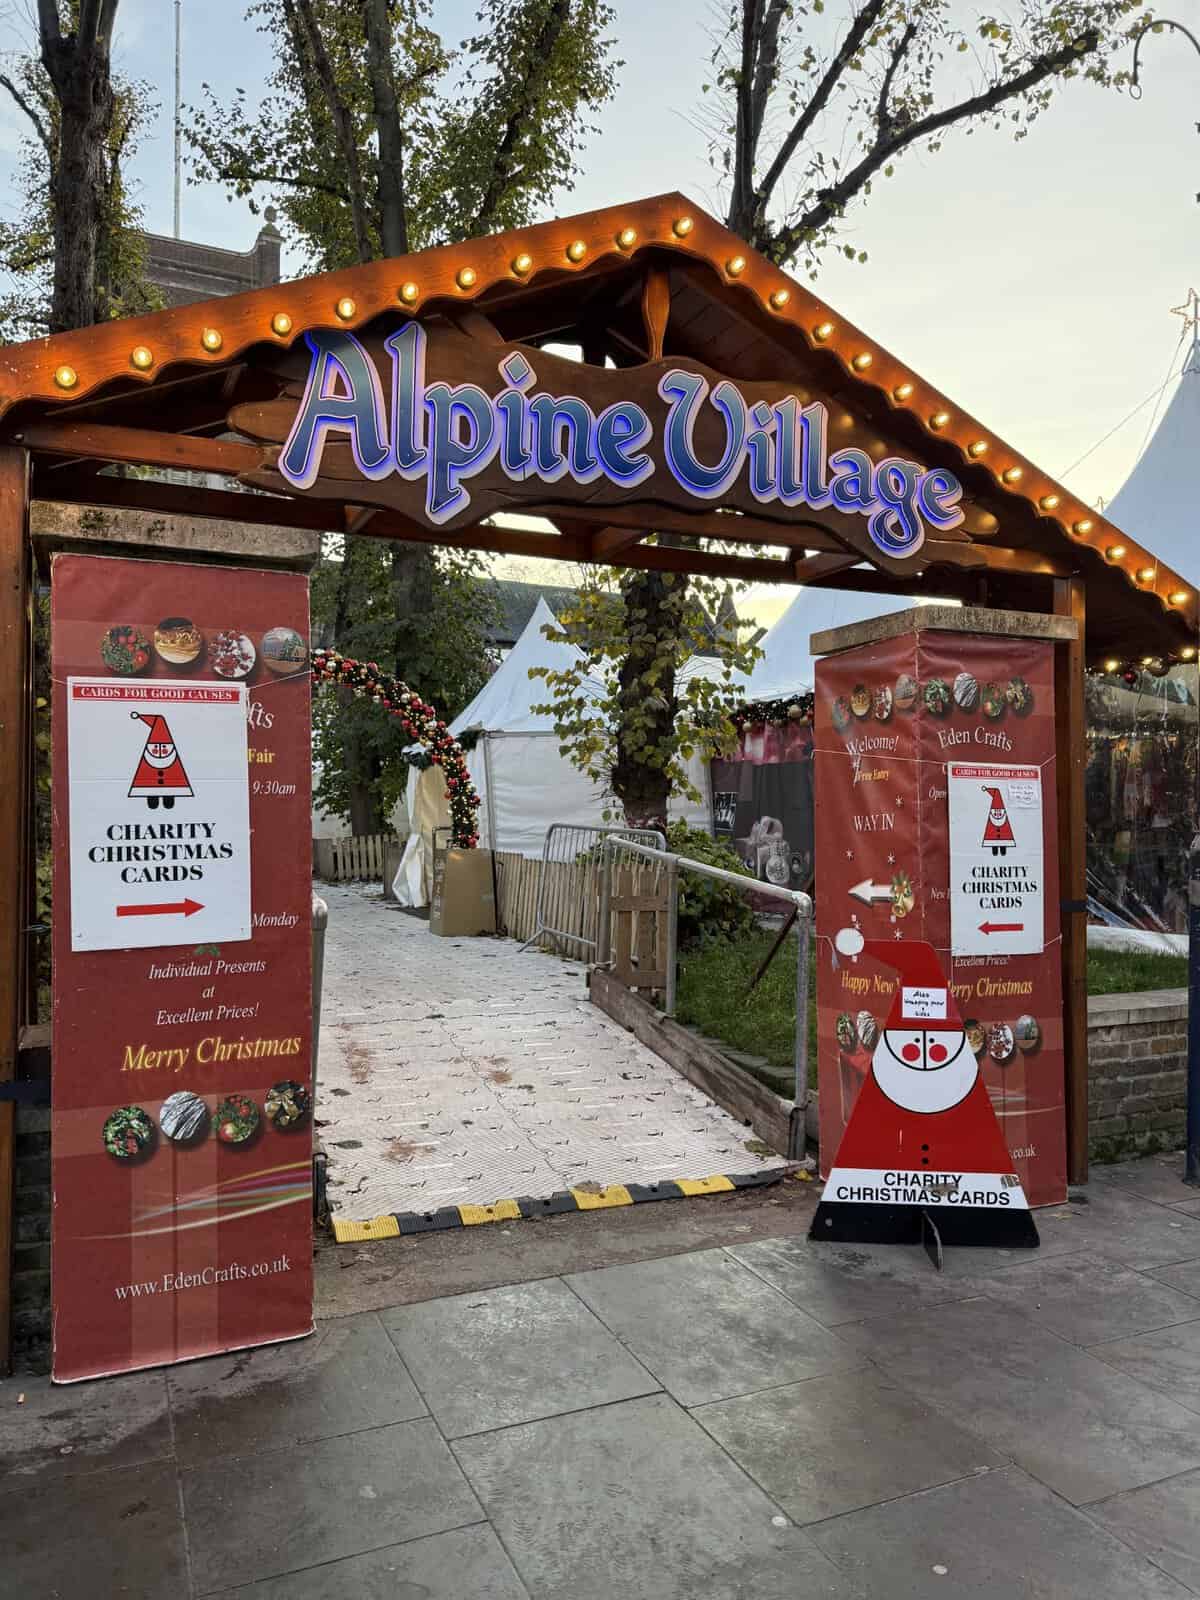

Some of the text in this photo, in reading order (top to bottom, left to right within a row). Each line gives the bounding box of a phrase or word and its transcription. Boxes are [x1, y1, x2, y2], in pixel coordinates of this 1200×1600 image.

[279, 321, 966, 561] Alpine Village
[80, 687, 233, 701] CARDS FOR GOOD CAUSES
[845, 735, 899, 755] Welcome!
[937, 726, 1014, 752] Eden Crafts
[248, 747, 275, 763] Fair
[252, 780, 296, 796] 9:30am
[106, 822, 216, 842] CHARITY
[854, 813, 895, 832] WAY IN
[88, 842, 234, 864] CHRISTMAS
[120, 864, 204, 884] CARDS
[972, 866, 1029, 879] CHARITY
[962, 881, 1038, 894] CHRISTMAS
[979, 896, 1023, 909] CARDS
[252, 911, 299, 929] Monday
[148, 959, 267, 980] Individual Presents
[202, 986, 216, 999] at
[841, 971, 871, 995] Happy
[873, 975, 894, 994] New
[976, 977, 1033, 998] Christmas
[156, 1002, 260, 1026] Excellent Prices!
[120, 1035, 302, 1073] Merry Christmas
[883, 1172, 963, 1188] CHARITY
[836, 1186, 1010, 1206] CHRISTMAS CARDS
[114, 1255, 292, 1301] www.EdenCrafts.co.uk
